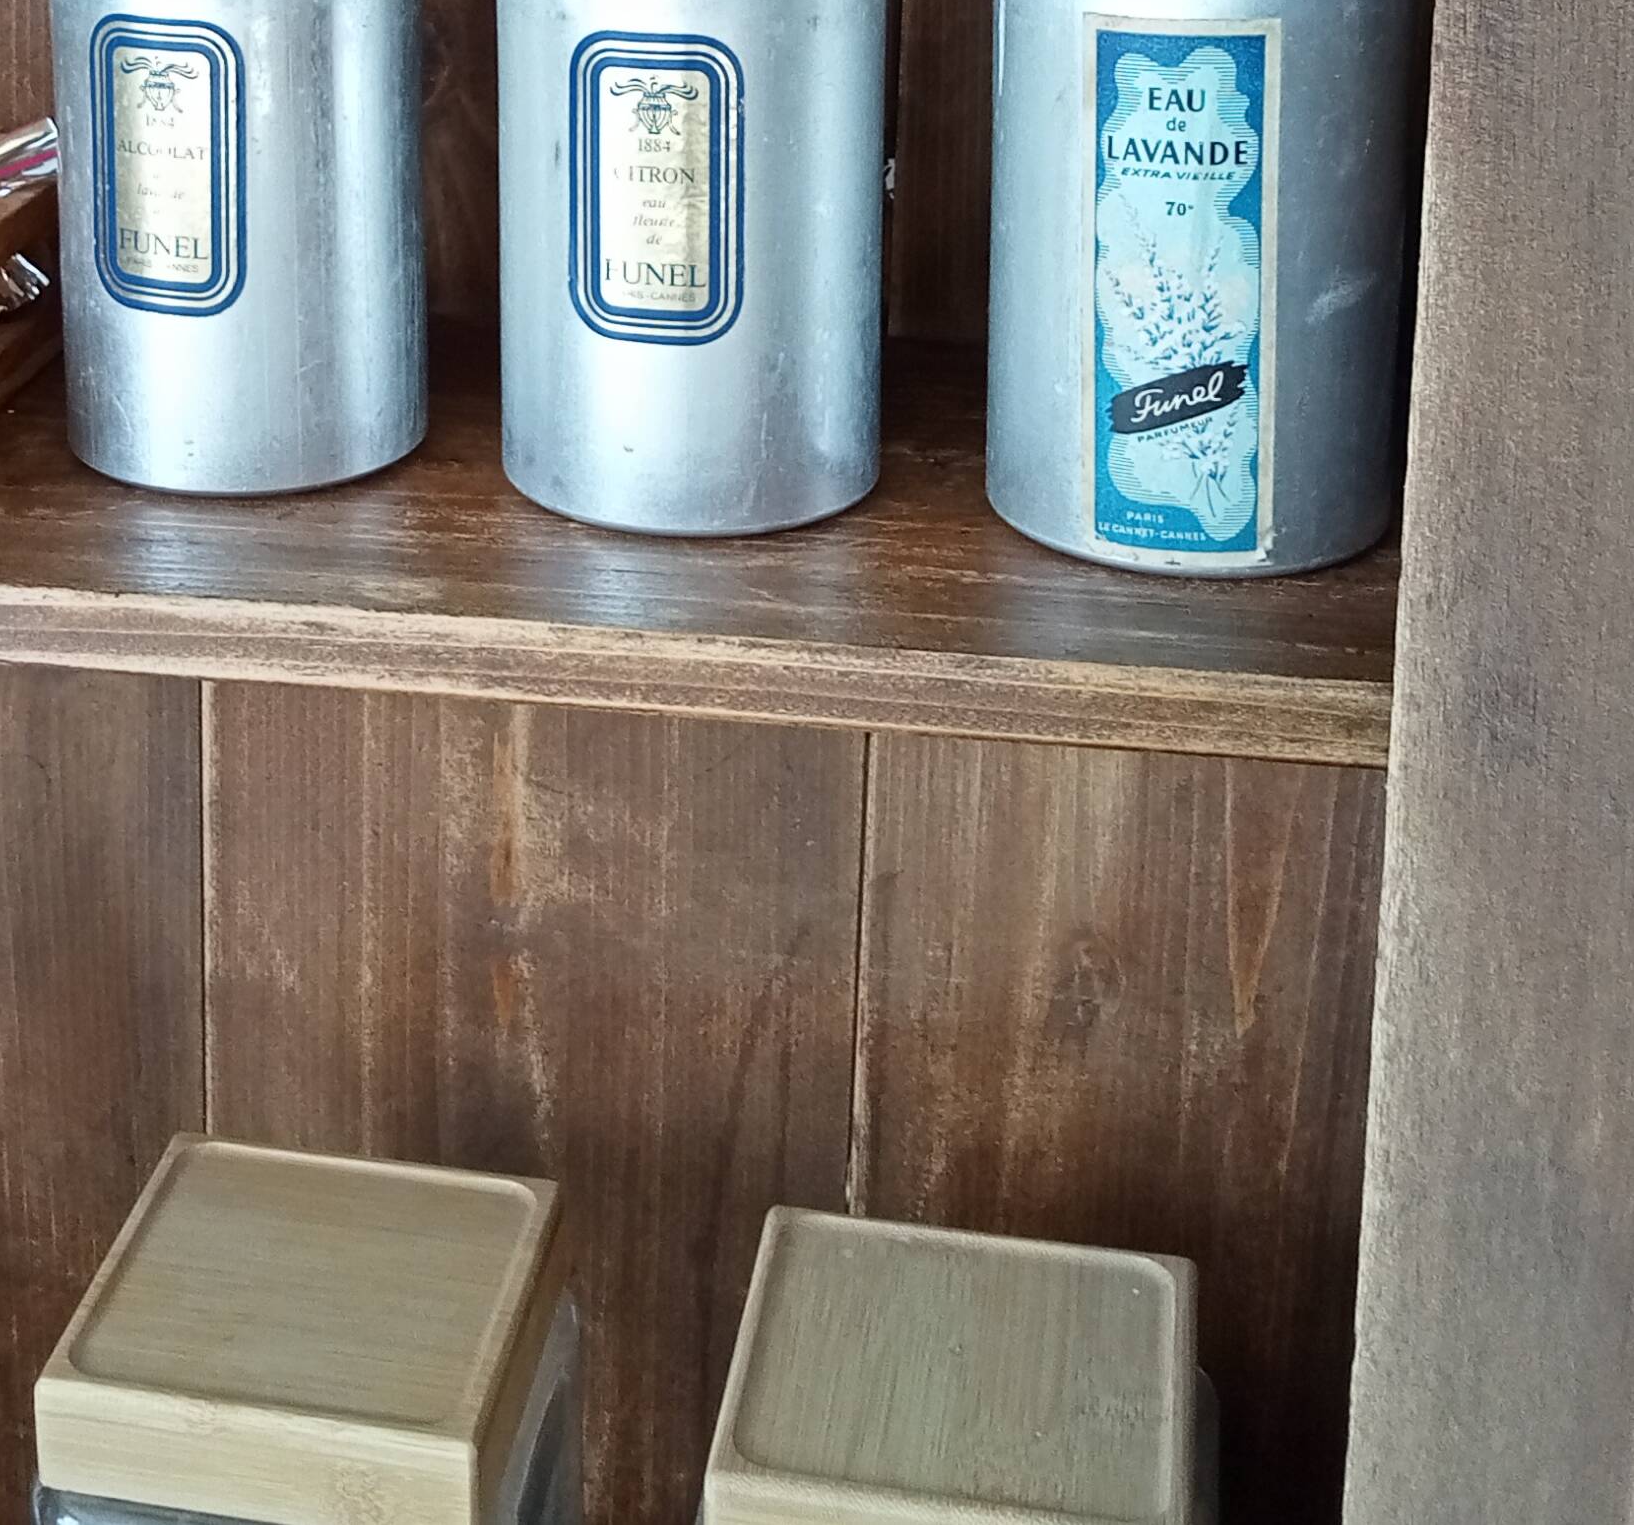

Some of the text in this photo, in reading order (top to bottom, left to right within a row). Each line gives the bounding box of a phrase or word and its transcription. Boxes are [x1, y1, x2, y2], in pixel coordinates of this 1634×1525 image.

[1148, 87, 1206, 113] EAU
[1166, 117, 1186, 132] de
[637, 138, 670, 152] 1884
[1107, 135, 1248, 167] LAVANDE
[1121, 167, 1236, 182] EXTRA VIEILLE
[119, 226, 209, 259] FUNEL
[646, 233, 663, 245] de
[605, 257, 706, 288] FUNEL
[1130, 370, 1224, 423] Funel
[1137, 417, 1214, 443] PARFUMEUR
[1126, 511, 1164, 524] PARIS
